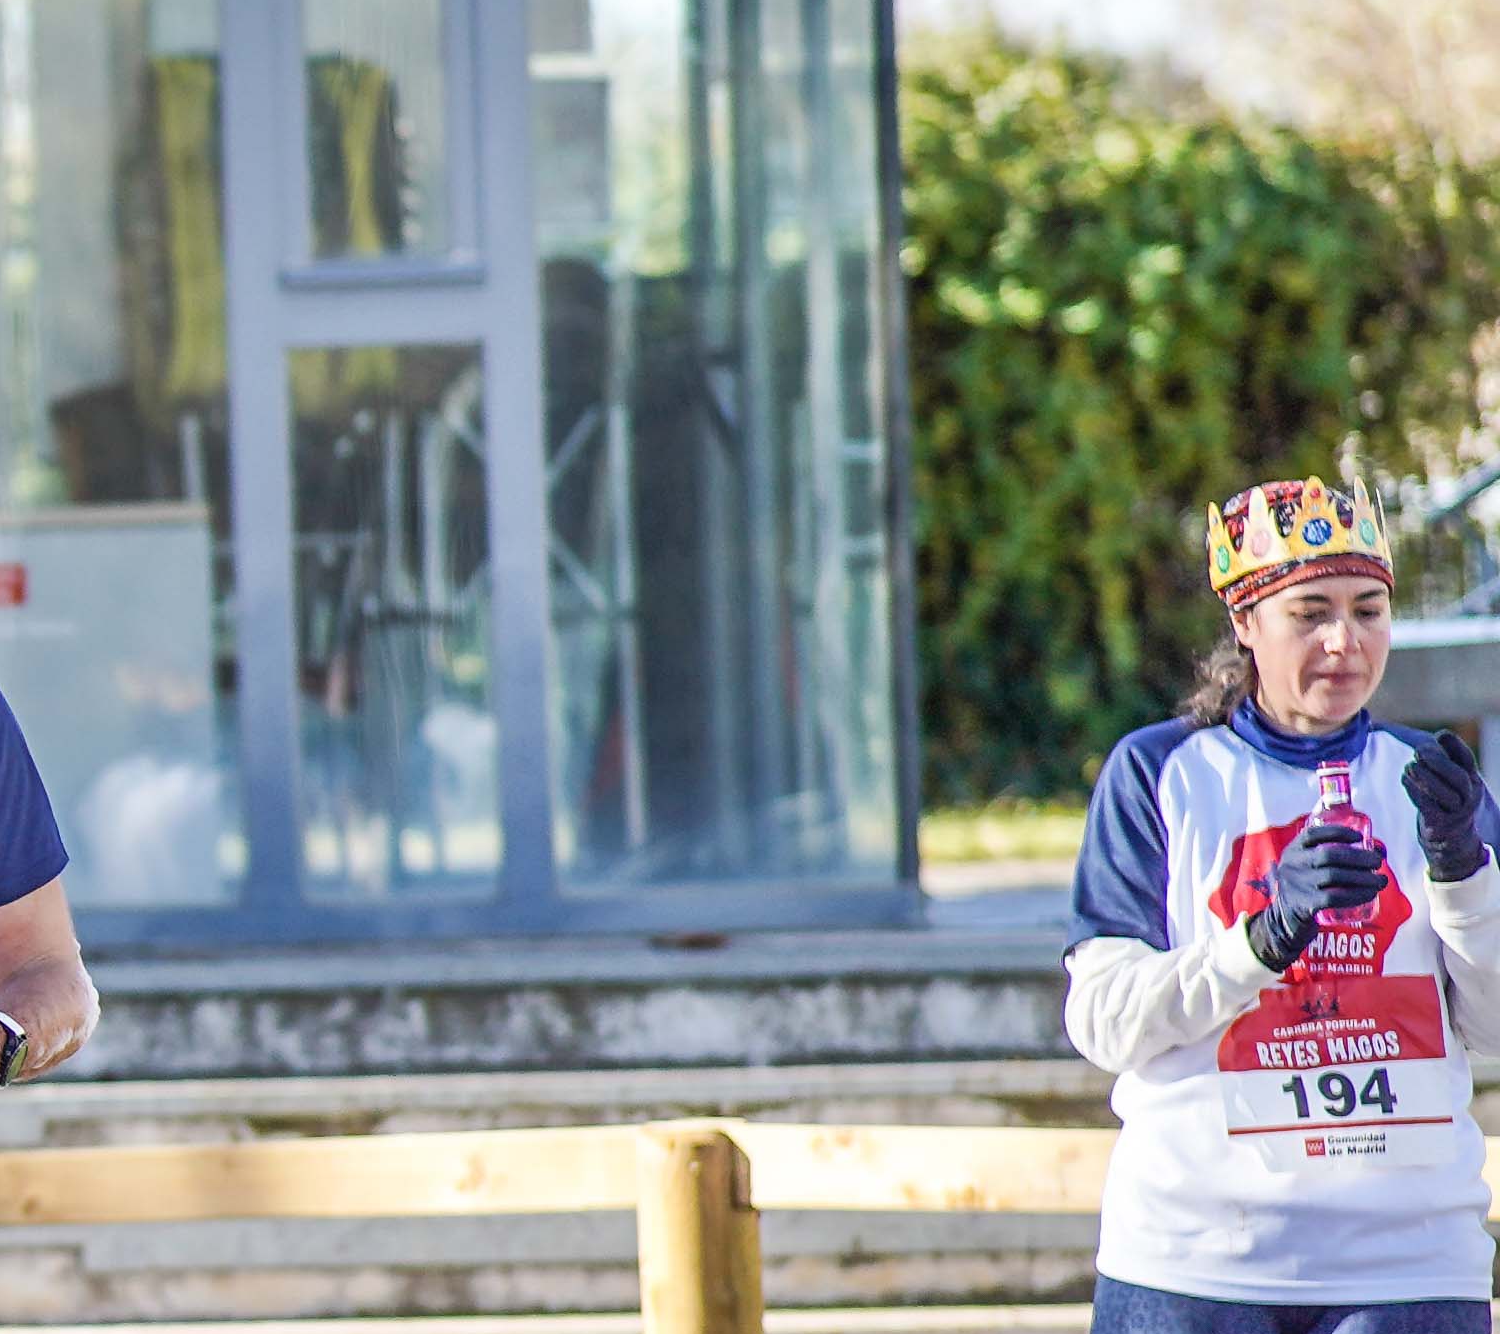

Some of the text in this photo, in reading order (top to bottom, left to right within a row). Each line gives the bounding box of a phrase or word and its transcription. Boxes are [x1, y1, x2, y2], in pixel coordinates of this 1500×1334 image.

[1308, 931, 1376, 960] MAGOS
[1328, 963, 1374, 975] MADRID
[1325, 1018, 1377, 1032] POPULAR
[1256, 1030, 1401, 1068] REYES MAGOS
[1282, 1067, 1398, 1119] 194
[1347, 1143, 1386, 1156] Madrid
